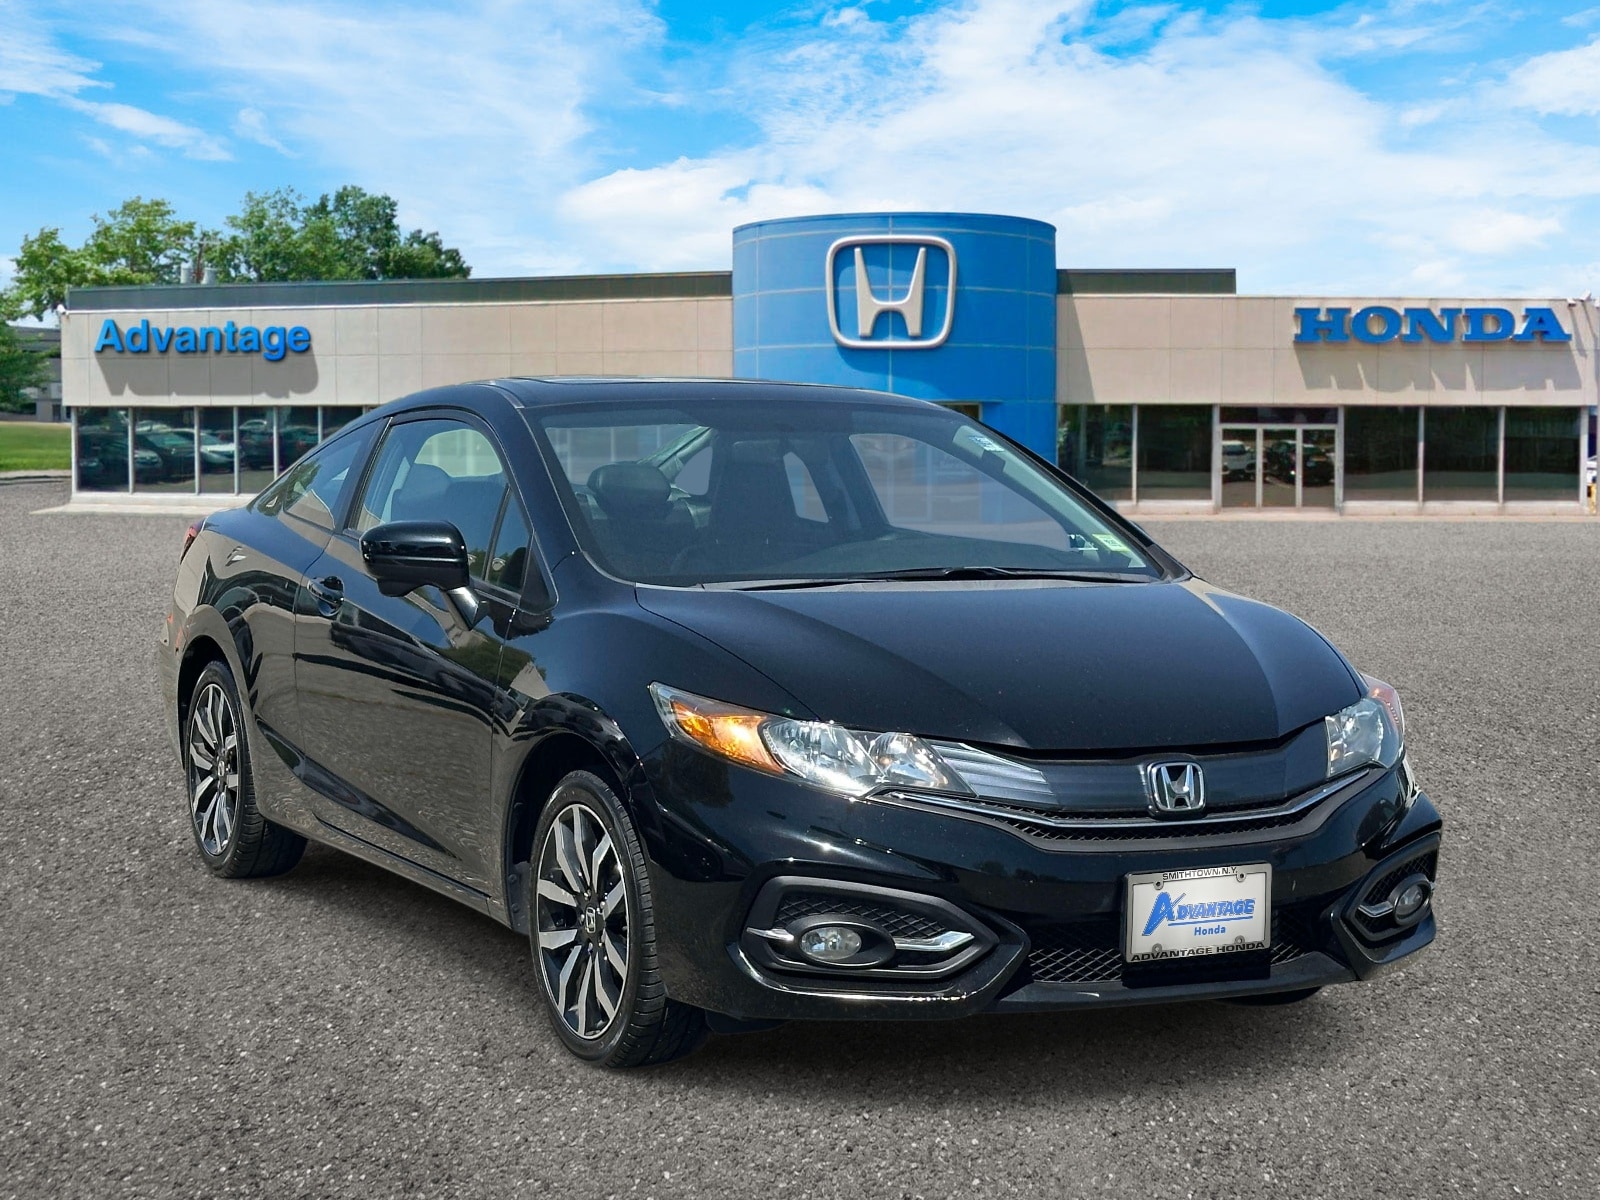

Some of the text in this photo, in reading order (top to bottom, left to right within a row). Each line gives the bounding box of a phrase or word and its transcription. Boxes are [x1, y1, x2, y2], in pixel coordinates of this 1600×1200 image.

[94, 318, 311, 361] Advantage
[1294, 306, 1572, 343] HONDA
[1142, 891, 1256, 936] ADVANTAGE
[1194, 925, 1226, 936] Honda
[1131, 941, 1265, 962] ADVANTAGE HONDA
